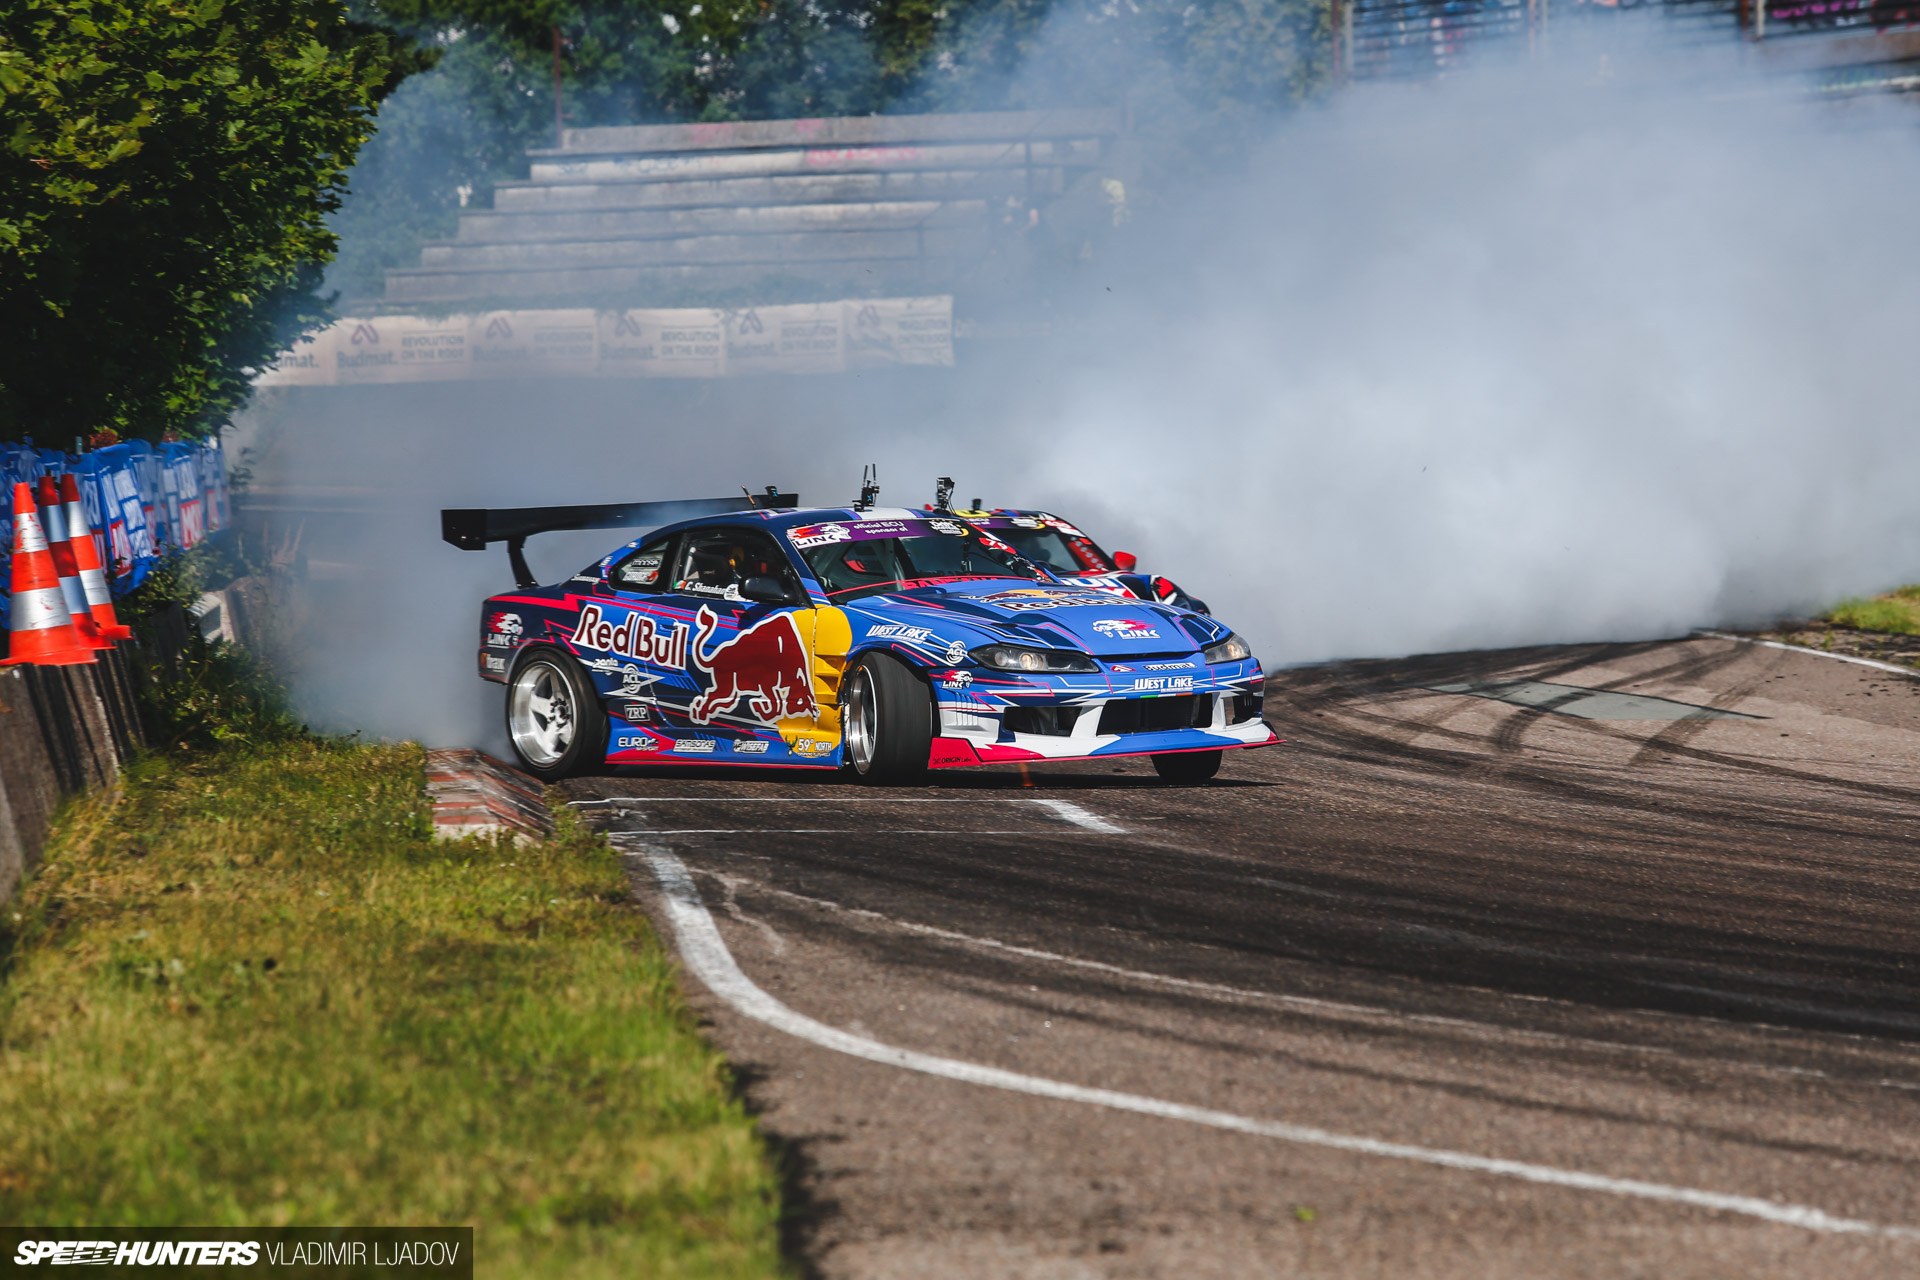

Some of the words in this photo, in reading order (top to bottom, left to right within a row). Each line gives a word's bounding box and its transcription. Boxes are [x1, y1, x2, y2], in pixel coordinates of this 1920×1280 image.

[402, 336, 464, 347] REVOLUTION
[795, 534, 838, 547] LINK
[487, 633, 511, 646] LINK
[570, 604, 638, 658] Red
[633, 615, 690, 671] Bull
[1117, 630, 1161, 639] LINK
[622, 673, 640, 684] ACL
[942, 680, 964, 690] LINK
[626, 707, 647, 719] ZRP
[618, 736, 649, 747] EURO
[815, 742, 833, 752] NORTH
